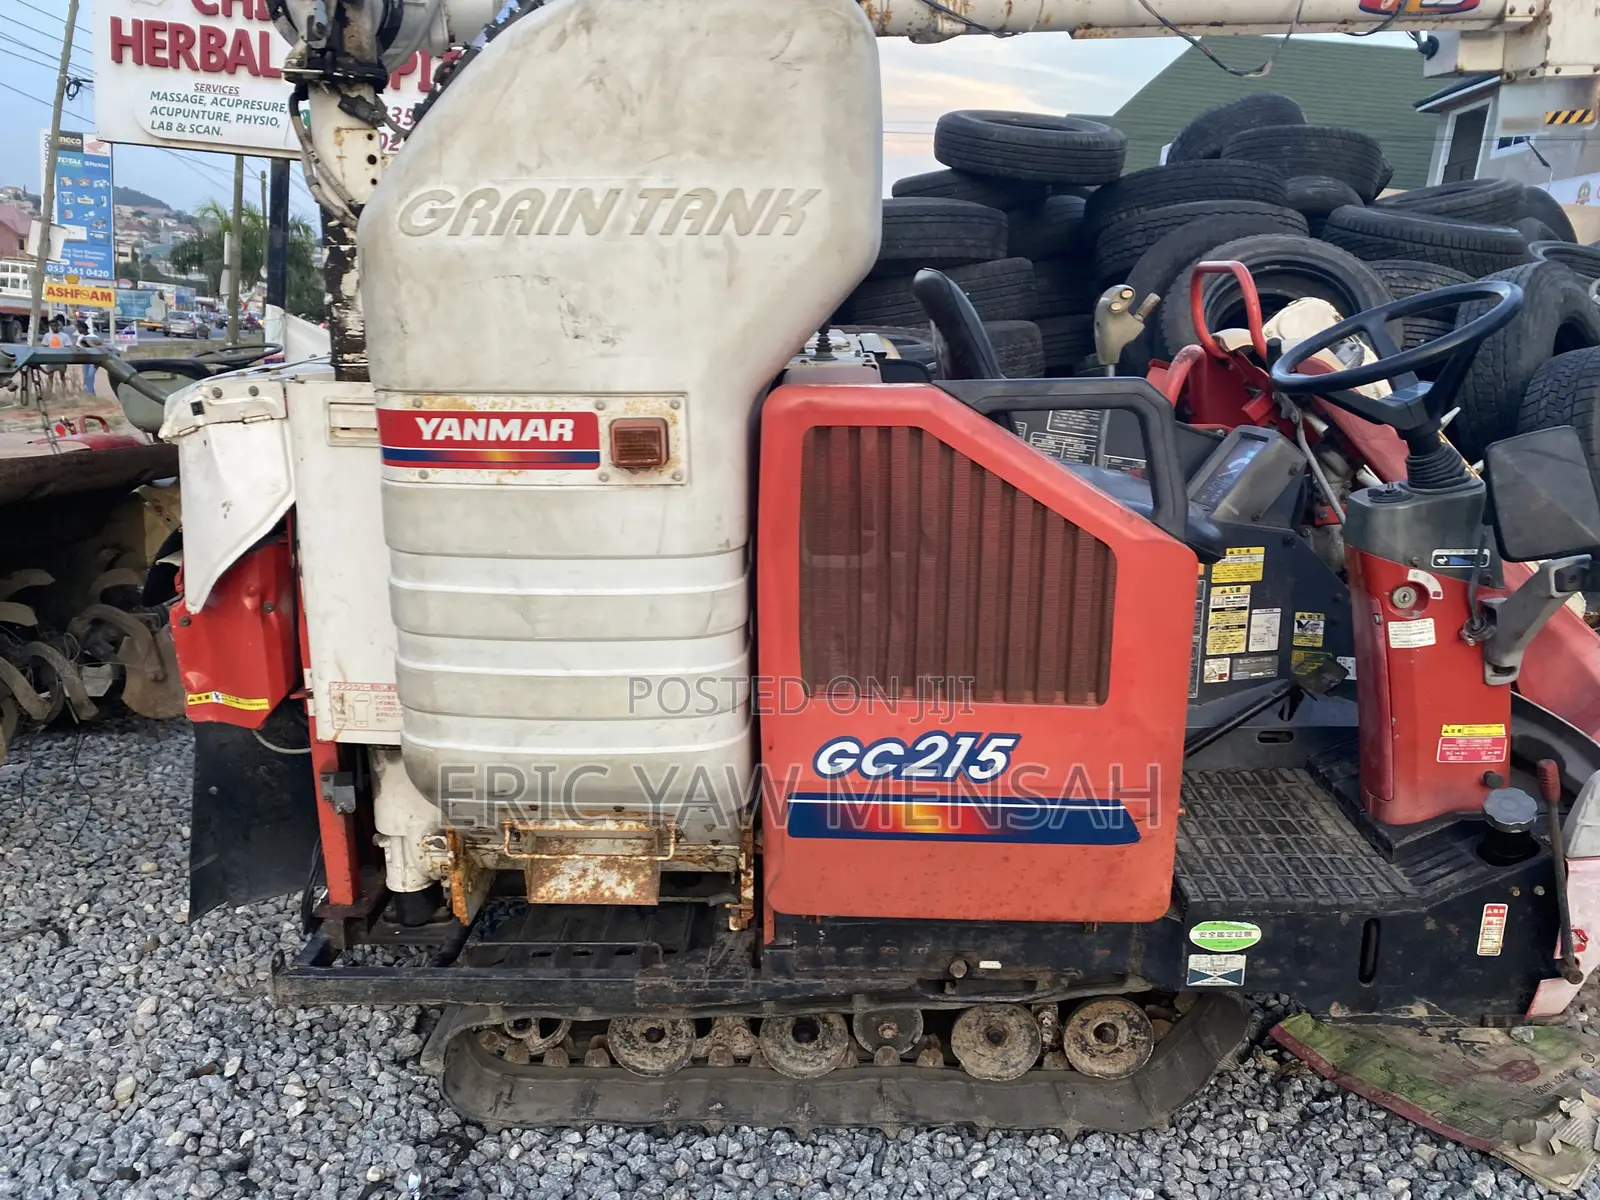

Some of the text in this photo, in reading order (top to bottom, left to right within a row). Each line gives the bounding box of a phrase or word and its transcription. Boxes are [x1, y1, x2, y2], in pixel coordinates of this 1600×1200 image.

[110, 16, 282, 78] HERBAL
[193, 82, 240, 95] SERVICES
[150, 90, 288, 114] MASSAGE, ACUPRESURE,
[150, 105, 280, 128] ACUPUNTURE, PHYSIO,
[150, 120, 223, 136] LAB & SCAN.
[398, 186, 823, 237] GRAIN TANK
[47, 264, 64, 274] 055
[86, 268, 110, 278] 0420
[414, 416, 575, 443] YANMAR
[814, 732, 1020, 783] GC215
